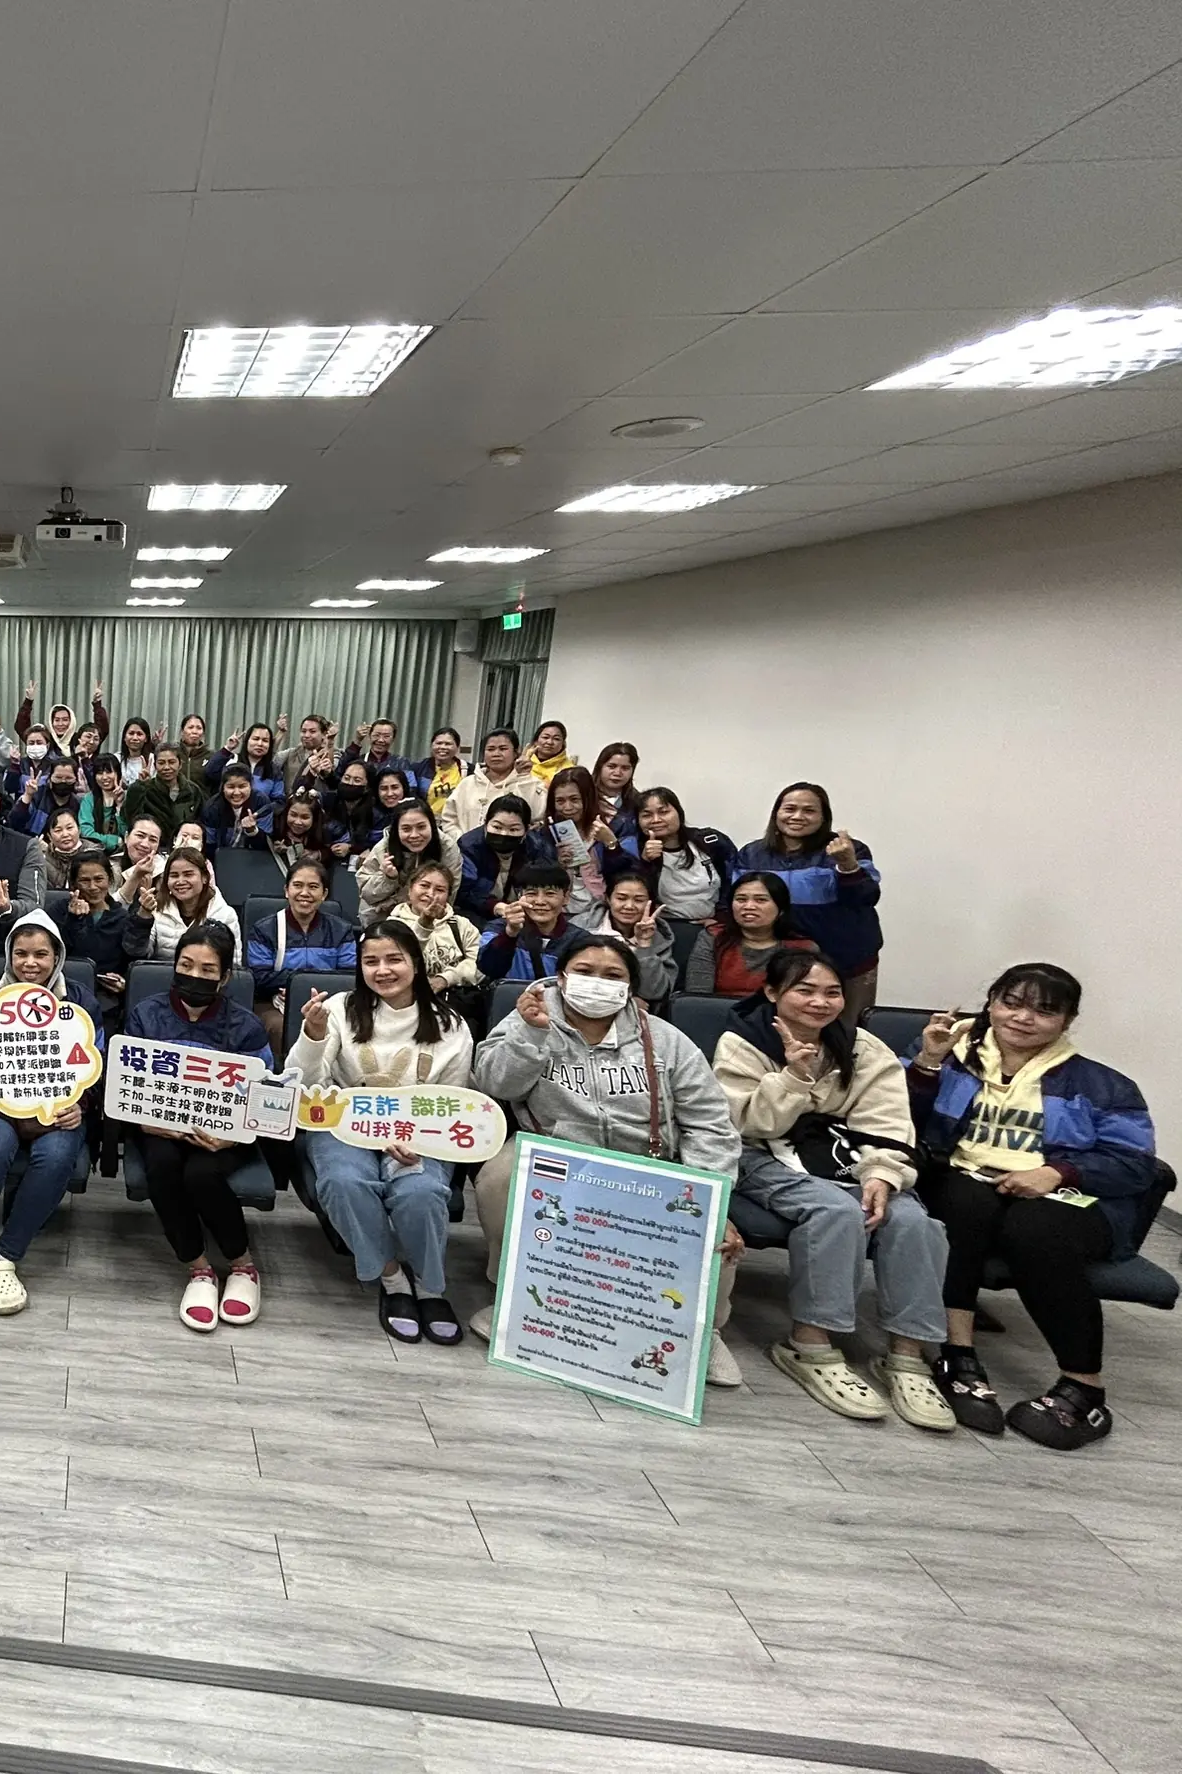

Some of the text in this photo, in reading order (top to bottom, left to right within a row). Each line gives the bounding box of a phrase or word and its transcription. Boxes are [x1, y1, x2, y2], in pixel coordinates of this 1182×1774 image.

[119, 1044, 246, 1088] 投資三不
[352, 1094, 400, 1116] 反詐
[351, 1119, 475, 1149] 叫我第一名
[574, 1213, 590, 1225] 200
[537, 1230, 549, 1239] 25
[596, 1280, 614, 1292] 300
[546, 1295, 570, 1308] 5,400
